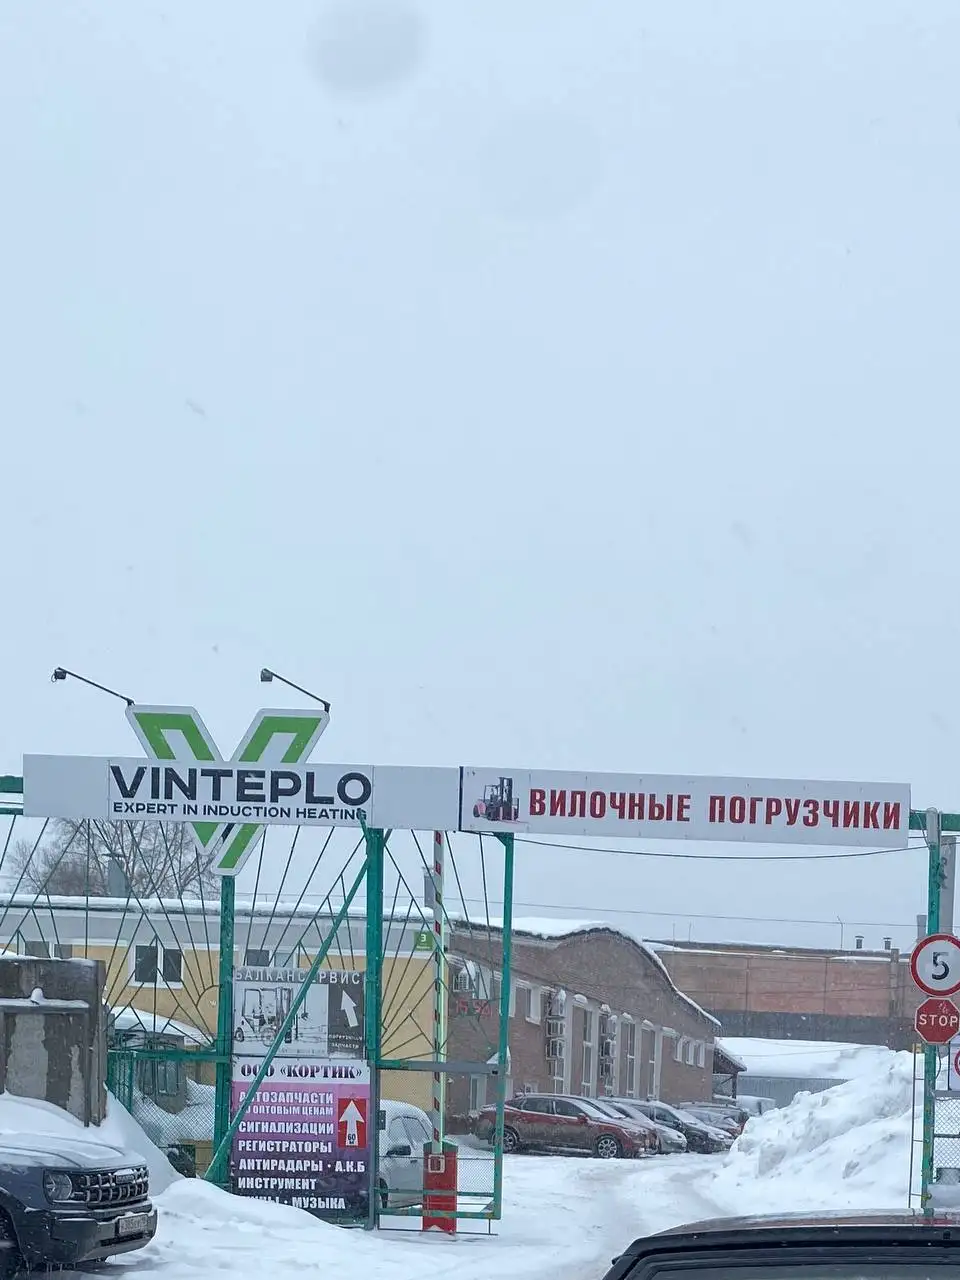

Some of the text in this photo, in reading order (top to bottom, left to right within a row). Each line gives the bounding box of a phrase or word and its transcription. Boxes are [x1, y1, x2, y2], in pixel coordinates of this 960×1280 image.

[110, 765, 371, 806] VINTEPLO
[113, 802, 367, 820] EXPERT IN INDUCTION HEATING
[528, 788, 900, 830] ВИЛОЧНЫЕ ПОГРУЗЧИКИ
[931, 952, 950, 981] 5
[235, 968, 360, 985] БАЛКАНСРВИС
[919, 1014, 958, 1027] STOP
[280, 1065, 362, 1078] «КОРТИК»
[239, 1091, 333, 1104] АТОЗАПЧАСТИ
[253, 1106, 300, 1115] ОПТОВЫМ
[302, 1107, 333, 1116] ЦЕНАМ
[238, 1121, 334, 1135] СИГНАЛИЗАЦИИ
[238, 1140, 332, 1153] РЕГИСТРАТОРЫ
[239, 1159, 323, 1172] АНТИРАДАРЫ
[238, 1177, 317, 1190] ИНСТРУМЕНТ
[291, 1196, 346, 1209] МУЗЫКА
